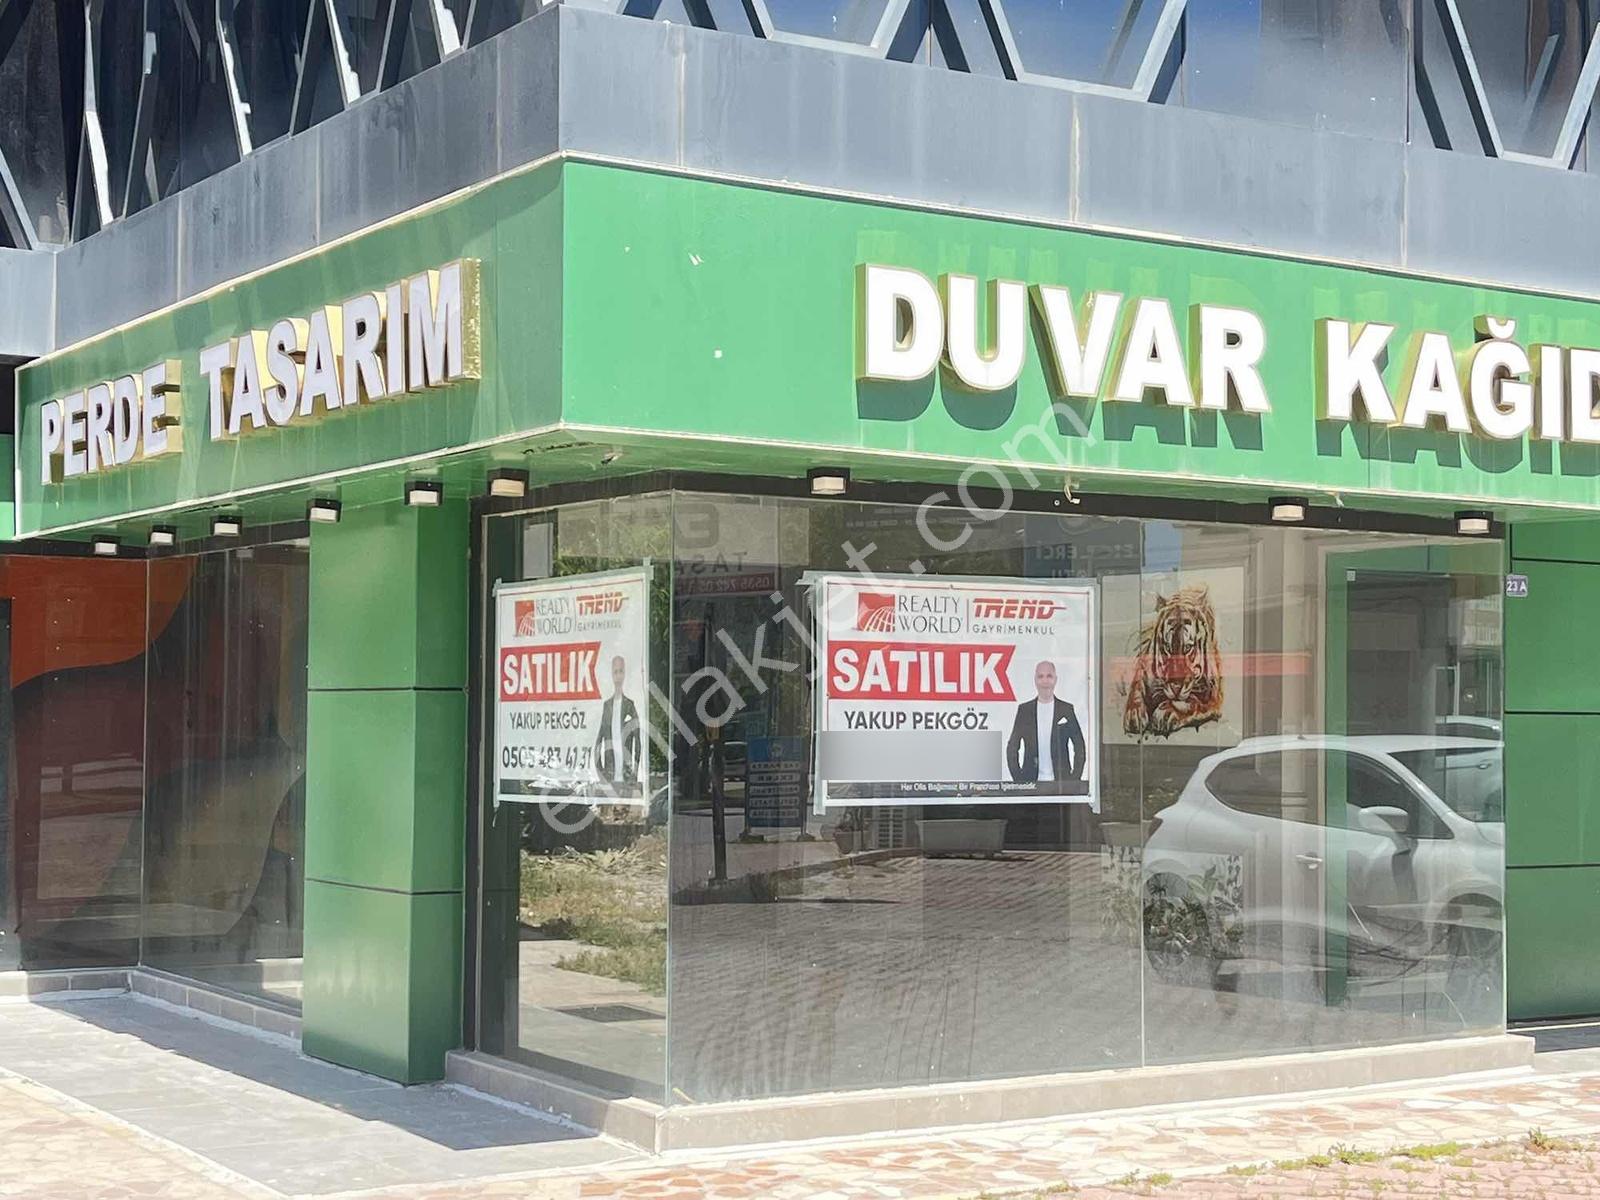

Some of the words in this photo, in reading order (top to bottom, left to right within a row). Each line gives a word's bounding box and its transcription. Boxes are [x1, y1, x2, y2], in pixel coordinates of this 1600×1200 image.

[859, 264, 1271, 414] DUVAR
[41, 360, 177, 485] PERDE
[200, 260, 473, 442] TASARIM
[1506, 581, 1518, 592] 23
[1520, 581, 1528, 592] A
[536, 595, 570, 618] REALTY
[576, 592, 629, 616] TREND
[898, 595, 960, 614] REALTY
[972, 597, 1067, 620] TREND
[537, 616, 572, 636] WORLD
[898, 614, 962, 634] WORLD
[503, 649, 594, 696] SATILIK
[832, 648, 1006, 695] SATILIK
[510, 711, 542, 730] YAKUP
[544, 707, 587, 730] PEKGÖZ
[844, 710, 907, 730] YAKUP
[912, 707, 989, 730] PEKGÖZ
